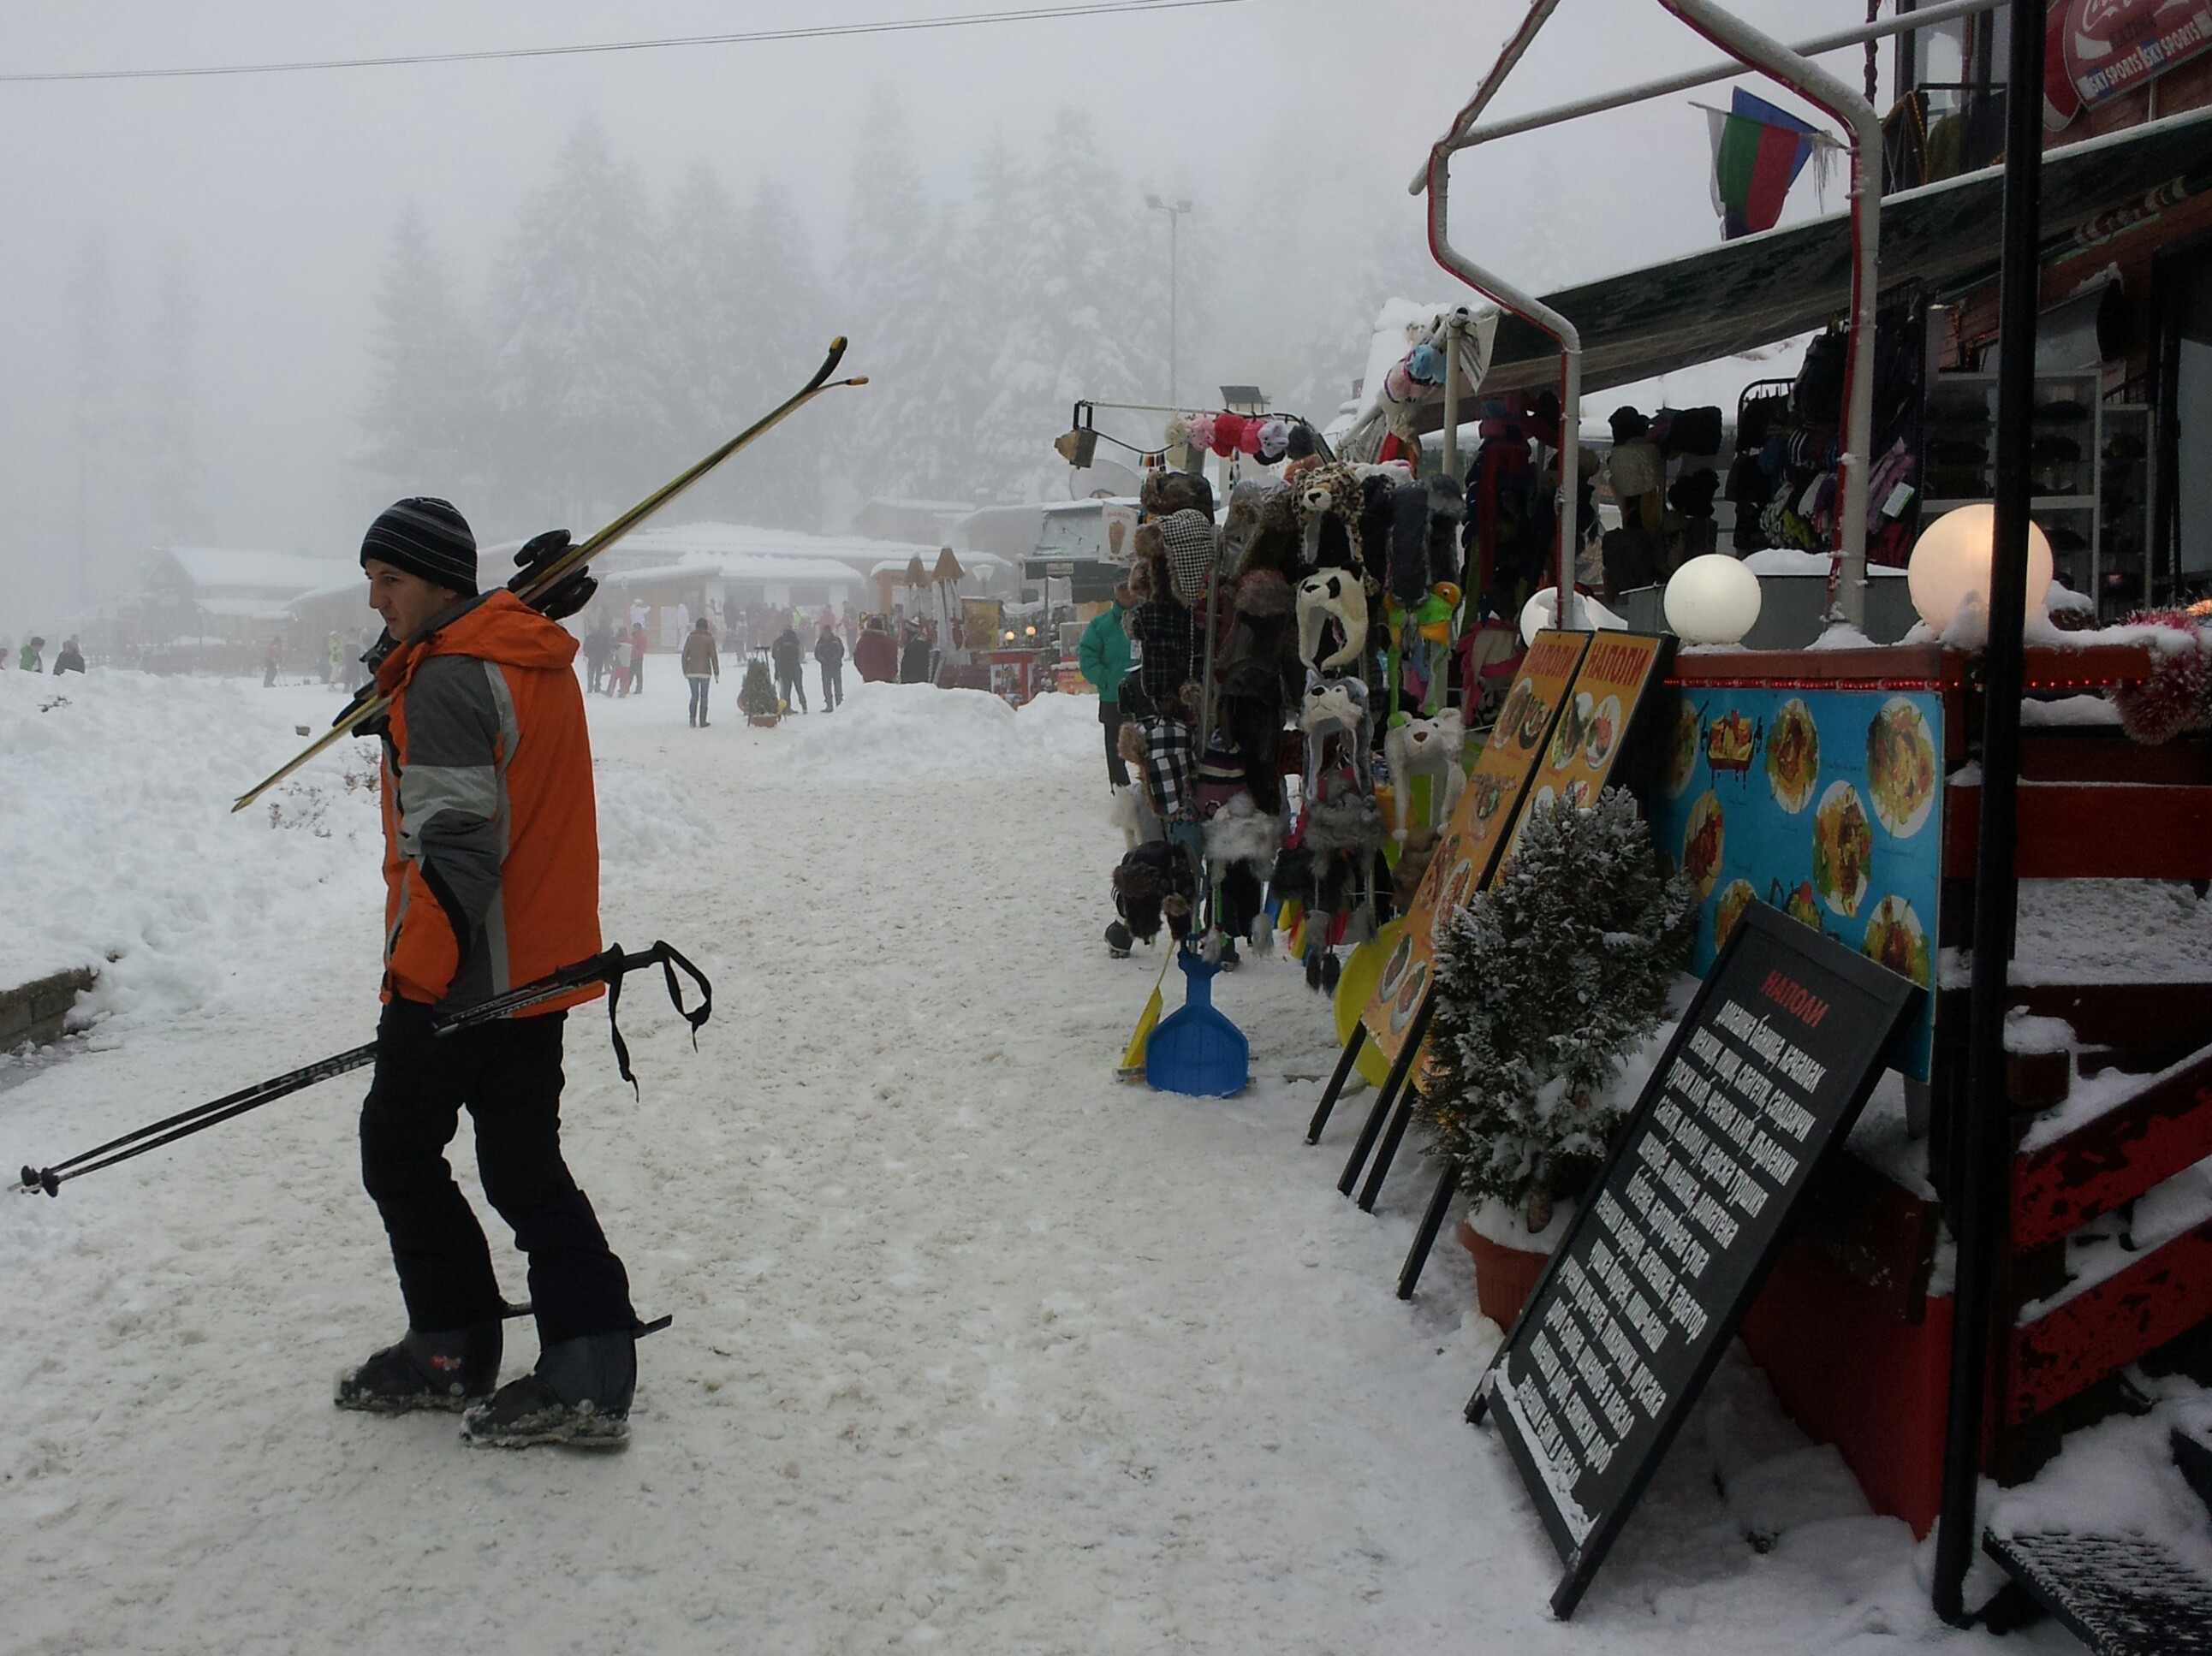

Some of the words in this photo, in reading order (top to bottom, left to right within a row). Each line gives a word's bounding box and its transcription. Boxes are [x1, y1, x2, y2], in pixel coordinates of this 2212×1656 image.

[2105, 53, 2143, 85] SPORTS
[2160, 21, 2201, 56] SPORTS
[1584, 643, 1650, 687] НАПОЛИ
[1761, 970, 1829, 1028] НАПОЛИ
[1712, 999, 1758, 1042] домашна
[1747, 1013, 1787, 1072] баница,
[1776, 1044, 1827, 1094] качамак
[1686, 1075, 1718, 1116] хляб,
[1704, 1089, 1739, 1131] чеснов
[1727, 1112, 1763, 1157] хляб,
[1746, 1130, 1799, 1186] пърленки
[1733, 1063, 1774, 1116] спагети,
[1764, 1088, 1817, 1143] сандвичи
[1637, 1131, 1673, 1183] шкембе,
[1661, 1158, 1701, 1217] пилешка,
[1687, 1191, 1739, 1250] доматена
[1700, 1143, 1738, 1189] царска
[1725, 1167, 1769, 1219] туршия
[1625, 1164, 1656, 1223] бобена,
[1646, 1197, 1692, 1259] картофена
[1680, 1239, 1710, 1279] супа
[1585, 1238, 1615, 1279] чушка
[1624, 1291, 1669, 1354] миш-маш
[1594, 1188, 1626, 1234] телешко
[1614, 1216, 1646, 1271] варено,
[1637, 1246, 1676, 1309] агнешка,
[1667, 1283, 1709, 1345] таратор
[1543, 1297, 1574, 1332] дроб
[1529, 1329, 1561, 1383] пилешки
[1546, 1366, 1579, 1415] дроб,
[1563, 1391, 1598, 1449] свински
[1583, 1432, 1620, 1475] дроб
[1575, 1344, 1613, 1399] шкембе
[1598, 1382, 1615, 1408] в
[1599, 1316, 1639, 1386] тиквички,
[1628, 1361, 1667, 1419] мусака
[1549, 1434, 1564, 1459] в
[1603, 1389, 1635, 1440] масло
